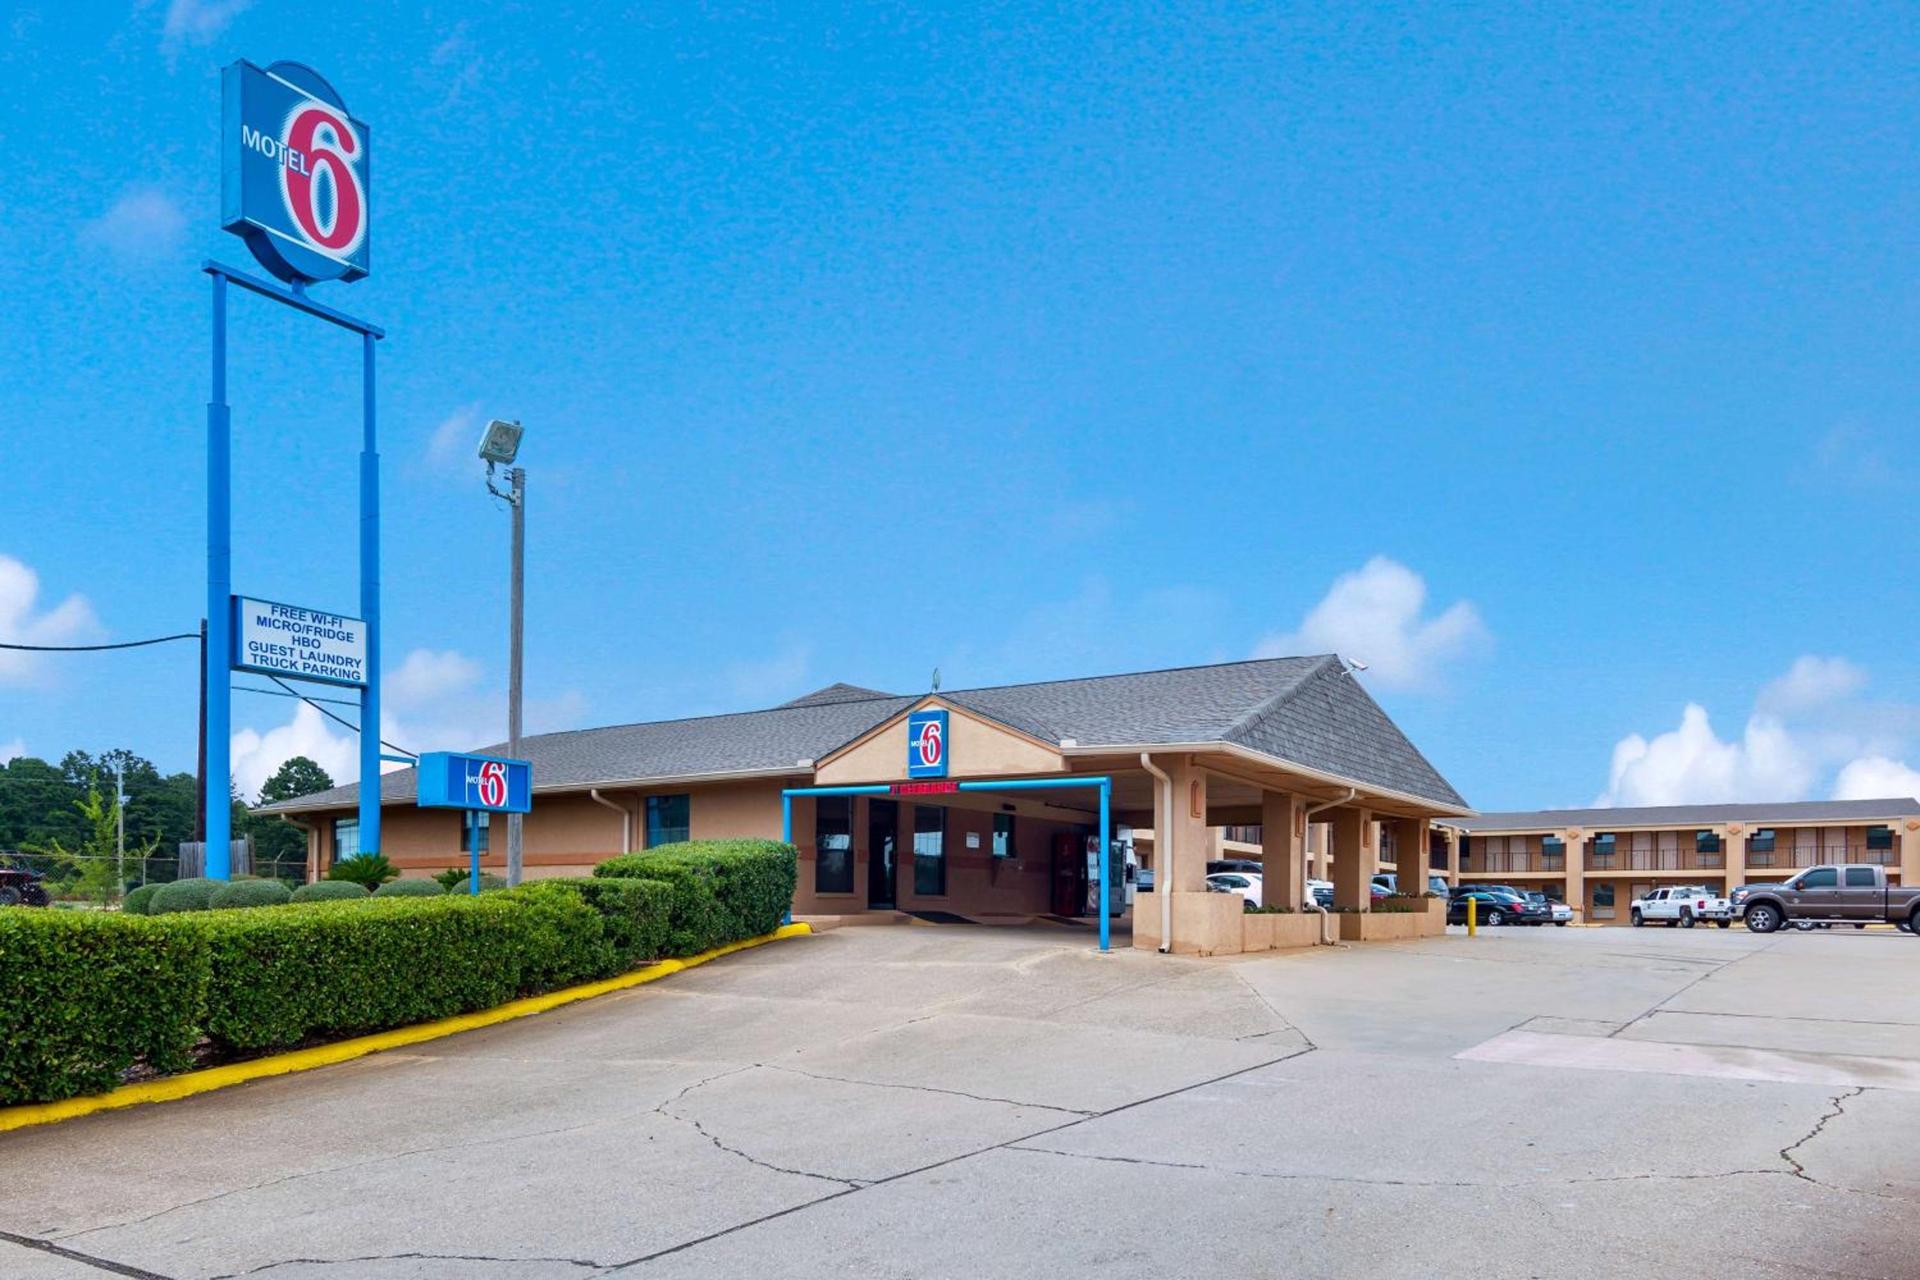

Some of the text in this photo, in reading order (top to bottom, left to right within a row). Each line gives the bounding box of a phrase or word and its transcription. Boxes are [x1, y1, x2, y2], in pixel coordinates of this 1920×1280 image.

[242, 103, 364, 254] MOTEL 6
[256, 615, 355, 643] MICRO/FRIDGE
[271, 605, 343, 629] FREE WI-FI
[248, 640, 362, 669] GUEST LAUNDRY
[291, 635, 321, 649] HBO
[250, 653, 361, 681] TRUCK PARKING
[920, 722, 942, 766] 6
[479, 761, 507, 807] 6
